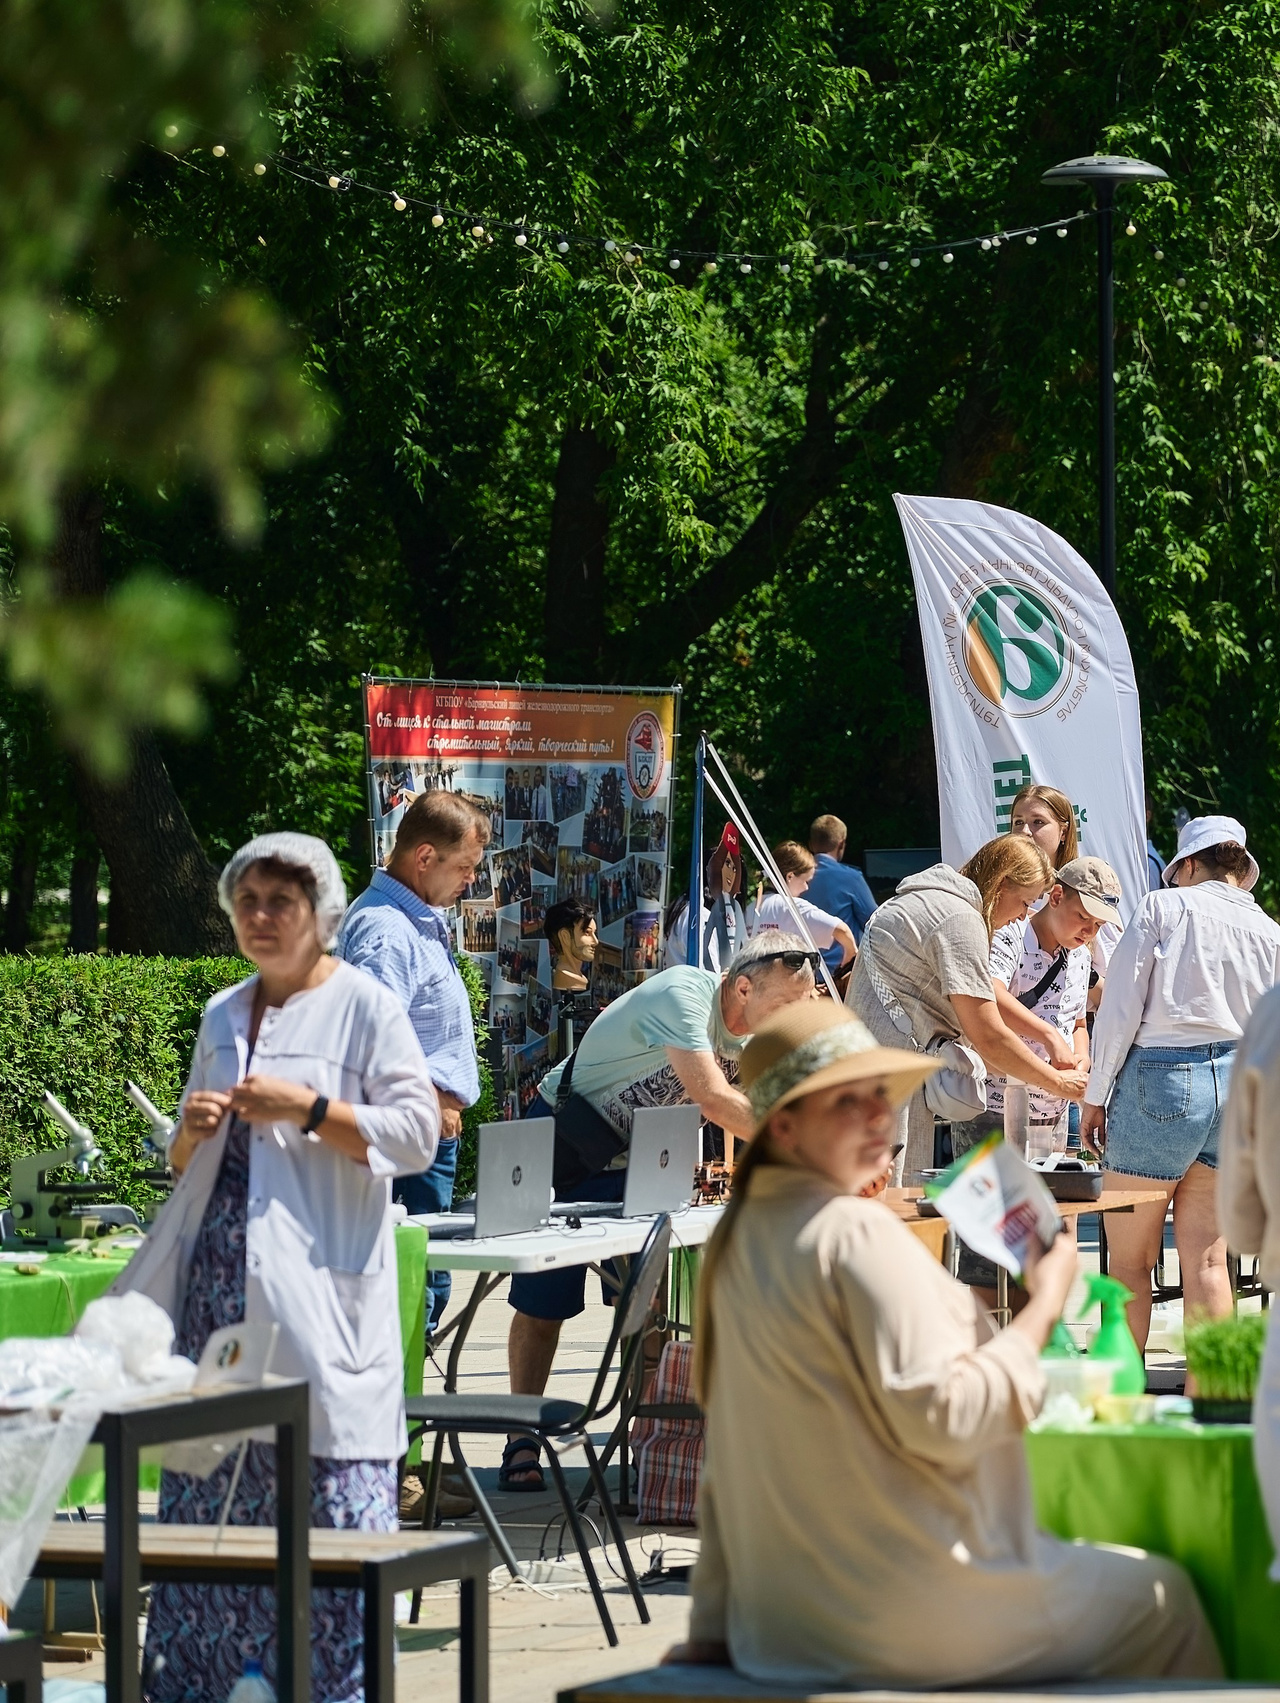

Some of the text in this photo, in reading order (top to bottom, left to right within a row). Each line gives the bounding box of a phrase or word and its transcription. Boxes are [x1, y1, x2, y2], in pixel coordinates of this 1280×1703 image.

[435, 695, 615, 715] КГБПОУ «Барнаульский лицей железнодорожного транспорта»
[376, 711, 393, 728] От
[394, 714, 422, 732] лицея
[432, 714, 475, 730] стальной
[476, 716, 532, 736] магистрали
[427, 734, 502, 755] стремительный,
[538, 738, 587, 757] творческий
[588, 739, 615, 757] путь!
[759, 922, 779, 930] отряд
